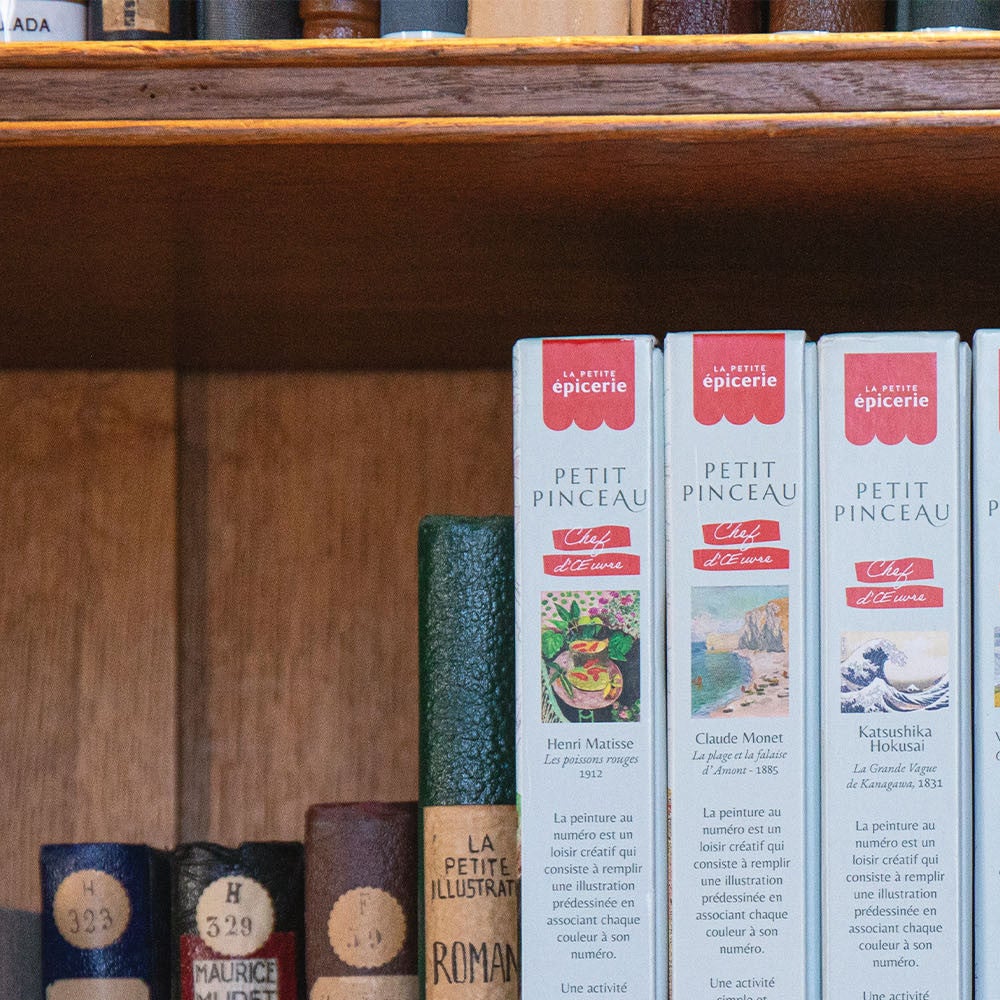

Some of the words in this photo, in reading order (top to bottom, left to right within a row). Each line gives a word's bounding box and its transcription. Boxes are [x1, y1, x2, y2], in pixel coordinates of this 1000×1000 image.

[579, 369, 616, 377] PETITE
[702, 372, 778, 393] épicerie
[552, 377, 627, 398] épicerie
[881, 384, 918, 392] PETITE
[854, 392, 929, 413] épicerie
[555, 466, 626, 485] PETIT
[705, 461, 776, 480] PETIT
[683, 483, 797, 507] PINCEAU
[856, 481, 929, 500] PETIT
[533, 488, 647, 513] PINCEAU
[835, 503, 950, 528] PINCEAU
[564, 527, 611, 557] Chef
[714, 522, 760, 551] Chef
[695, 732, 738, 745] Claude
[742, 732, 784, 744] Monet
[859, 724, 932, 739] Katsushika
[547, 738, 581, 751] Henri
[585, 737, 635, 750] Matisse
[870, 738, 925, 753] Hokusai
[543, 753, 561, 765] Les
[561, 755, 604, 768] poissons
[605, 755, 639, 768] rouges
[691, 750, 706, 761] La
[705, 749, 733, 764] plage
[733, 751, 744, 761] et
[743, 748, 755, 761] la
[753, 748, 789, 764] falaise
[579, 769, 603, 780] 1912
[756, 764, 779, 776] 1885
[853, 763, 867, 774] La
[869, 762, 906, 774] Grande
[909, 762, 938, 777] Vague
[846, 777, 859, 789] de
[860, 778, 916, 792] Kanagawa,
[918, 777, 943, 790] 1831
[703, 807, 716, 819] La
[719, 808, 765, 821] peinture
[768, 808, 782, 817] au
[468, 833, 495, 853] LA
[444, 857, 511, 877] PETITE
[83, 879, 95, 897] H
[225, 881, 242, 904] H
[431, 877, 518, 900] ILLUSTRAT
[66, 908, 114, 934] 323
[206, 914, 253, 938] 329
[195, 960, 276, 984] MAURICE
